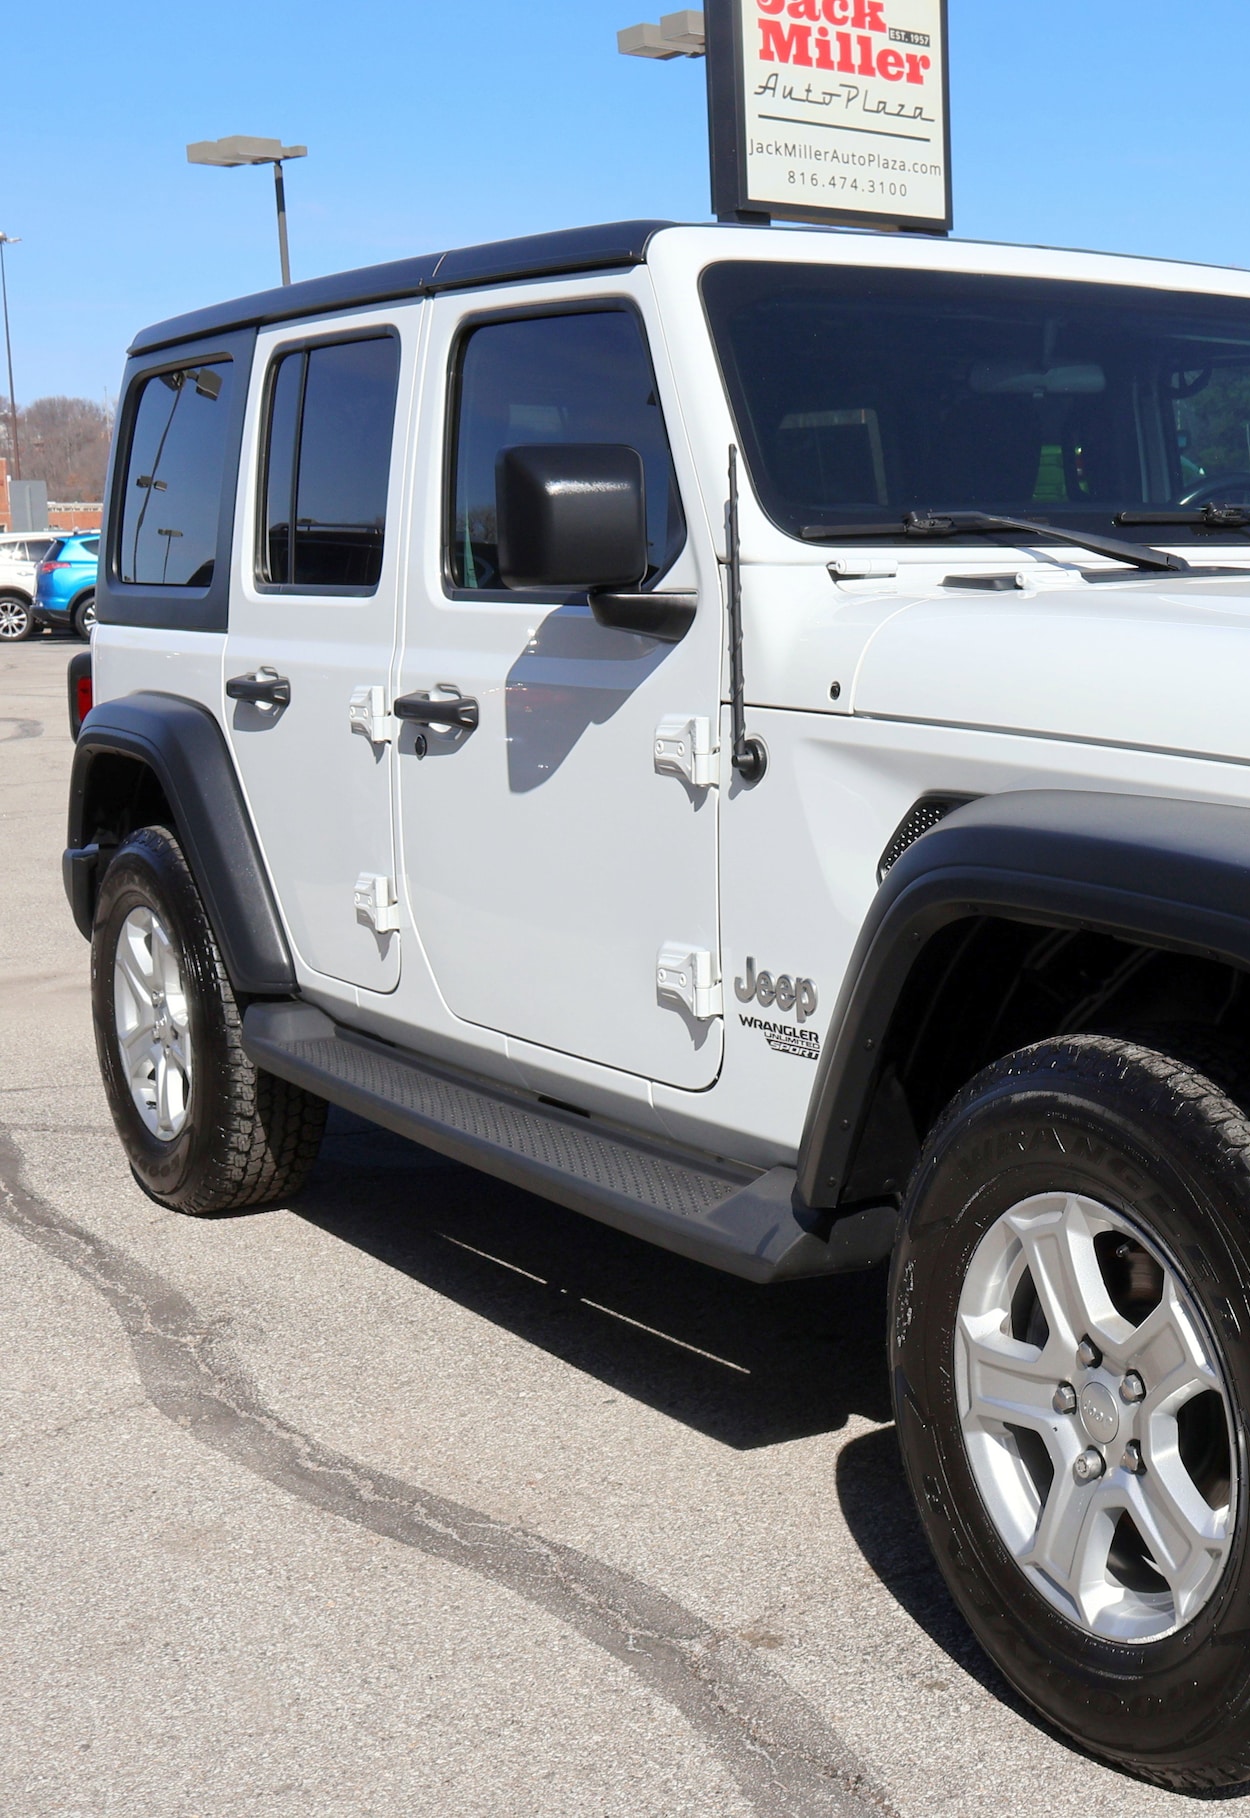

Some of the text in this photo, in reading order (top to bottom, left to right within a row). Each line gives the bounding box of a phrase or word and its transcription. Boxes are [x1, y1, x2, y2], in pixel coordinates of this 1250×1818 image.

[758, 18, 931, 85] Miller
[889, 29, 930, 46] EST. 1957
[748, 138, 942, 177] JackMillerAutoPlaza.com
[787, 170, 908, 197] 816.474.3100
[734, 956, 819, 1024] Jeep
[738, 1013, 820, 1044] WRANGLER
[764, 1031, 821, 1050] UNLIMITED
[768, 1040, 821, 1060] SPORT
